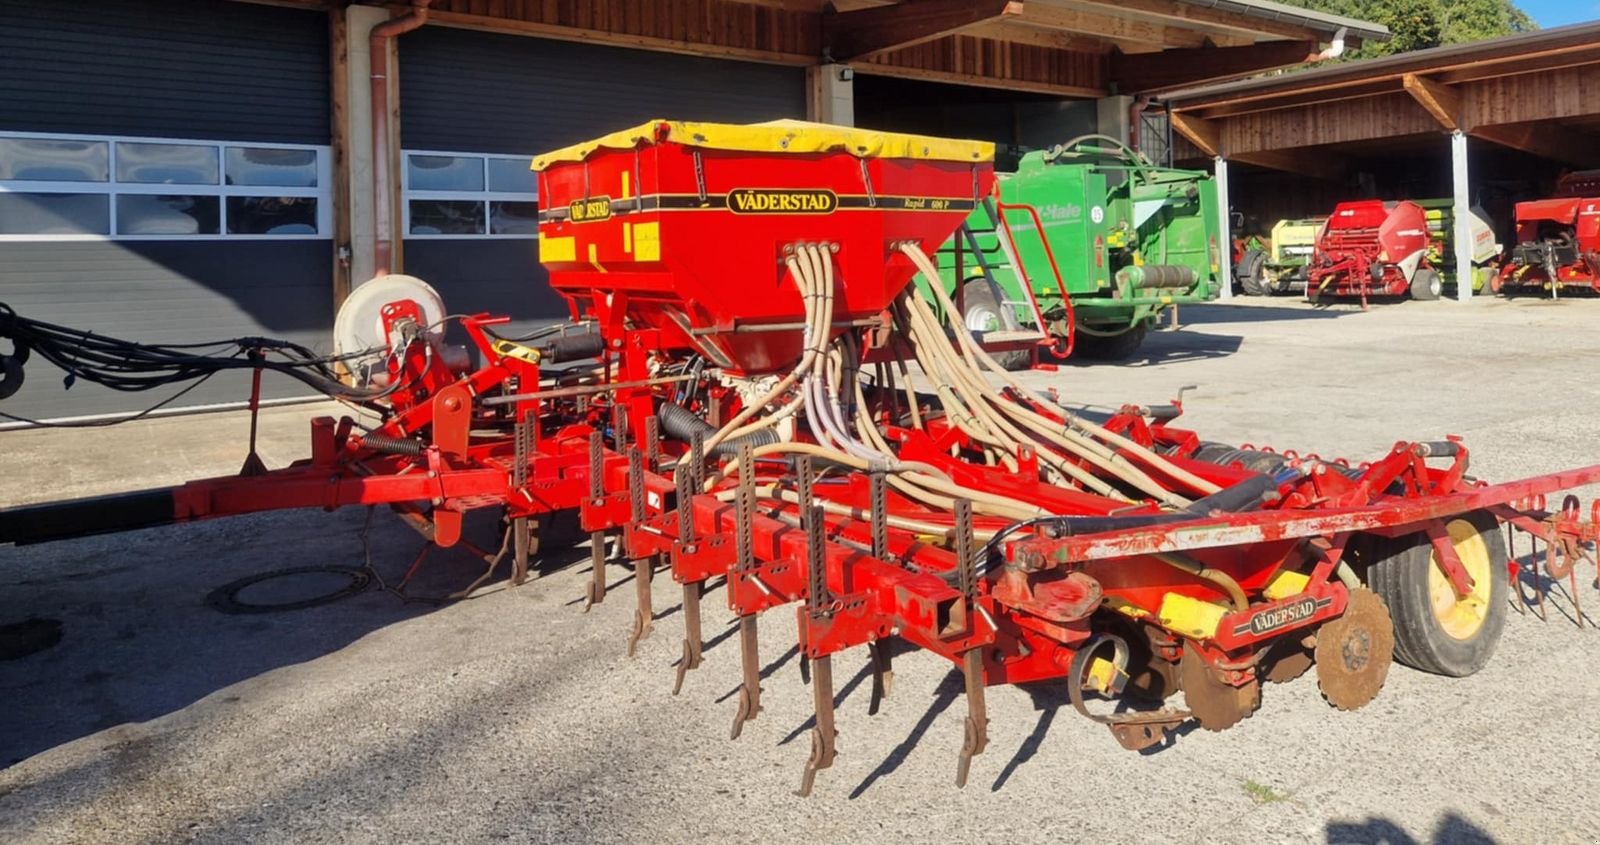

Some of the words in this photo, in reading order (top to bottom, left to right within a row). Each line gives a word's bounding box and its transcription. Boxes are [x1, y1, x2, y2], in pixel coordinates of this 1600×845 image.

[735, 190, 831, 210] VÄDERSTAD
[904, 198, 925, 209] Rapid
[571, 201, 609, 219] VÄDRSTAD
[1254, 602, 1313, 631] VÄDERSTAD
